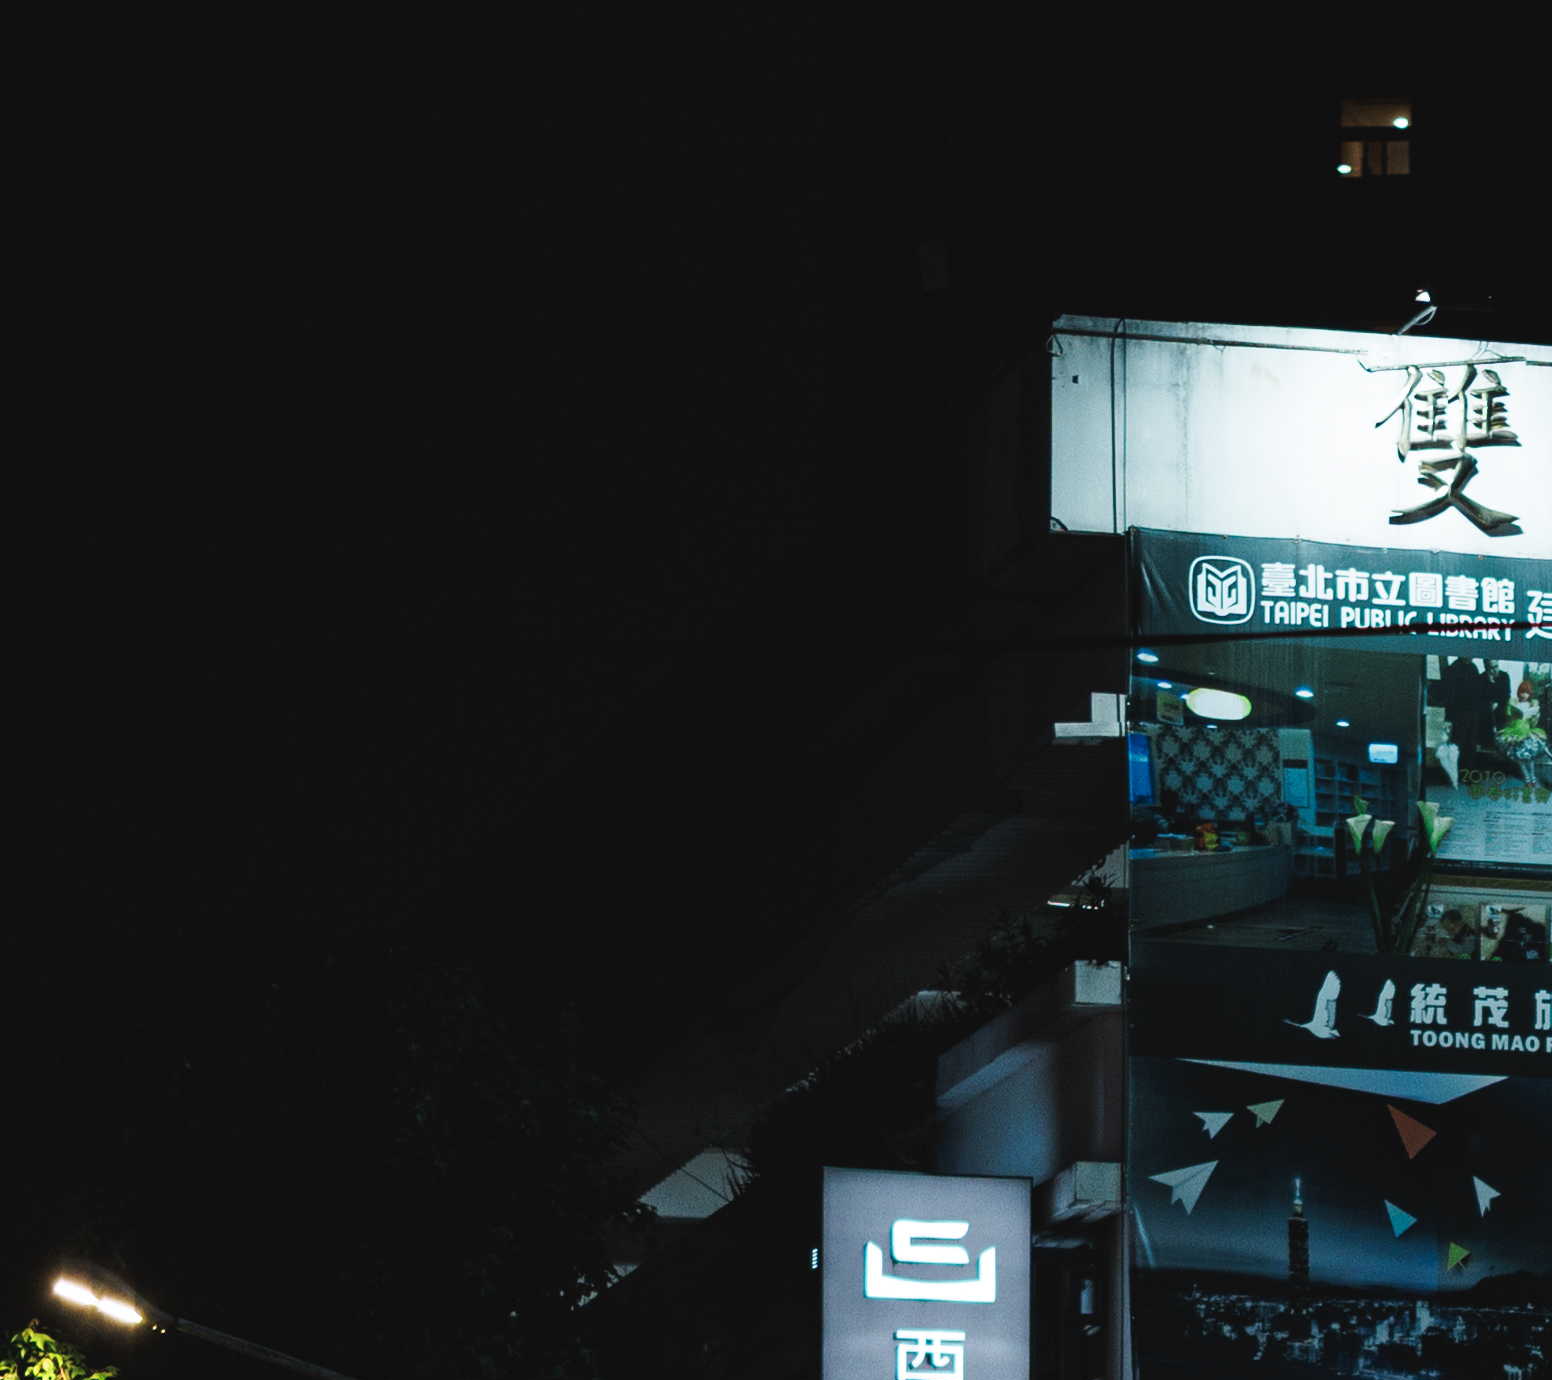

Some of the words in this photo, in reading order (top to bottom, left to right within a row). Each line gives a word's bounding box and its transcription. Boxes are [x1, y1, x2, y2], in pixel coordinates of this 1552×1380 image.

[1261, 562, 1516, 614] 臺北市立圖書館
[1261, 600, 1330, 627] TAIPEI
[1340, 605, 1418, 634] PUBLIC
[1425, 613, 1516, 642] LIBRARY
[1410, 1030, 1486, 1050] TOONG
[1490, 1034, 1541, 1053] MAO
